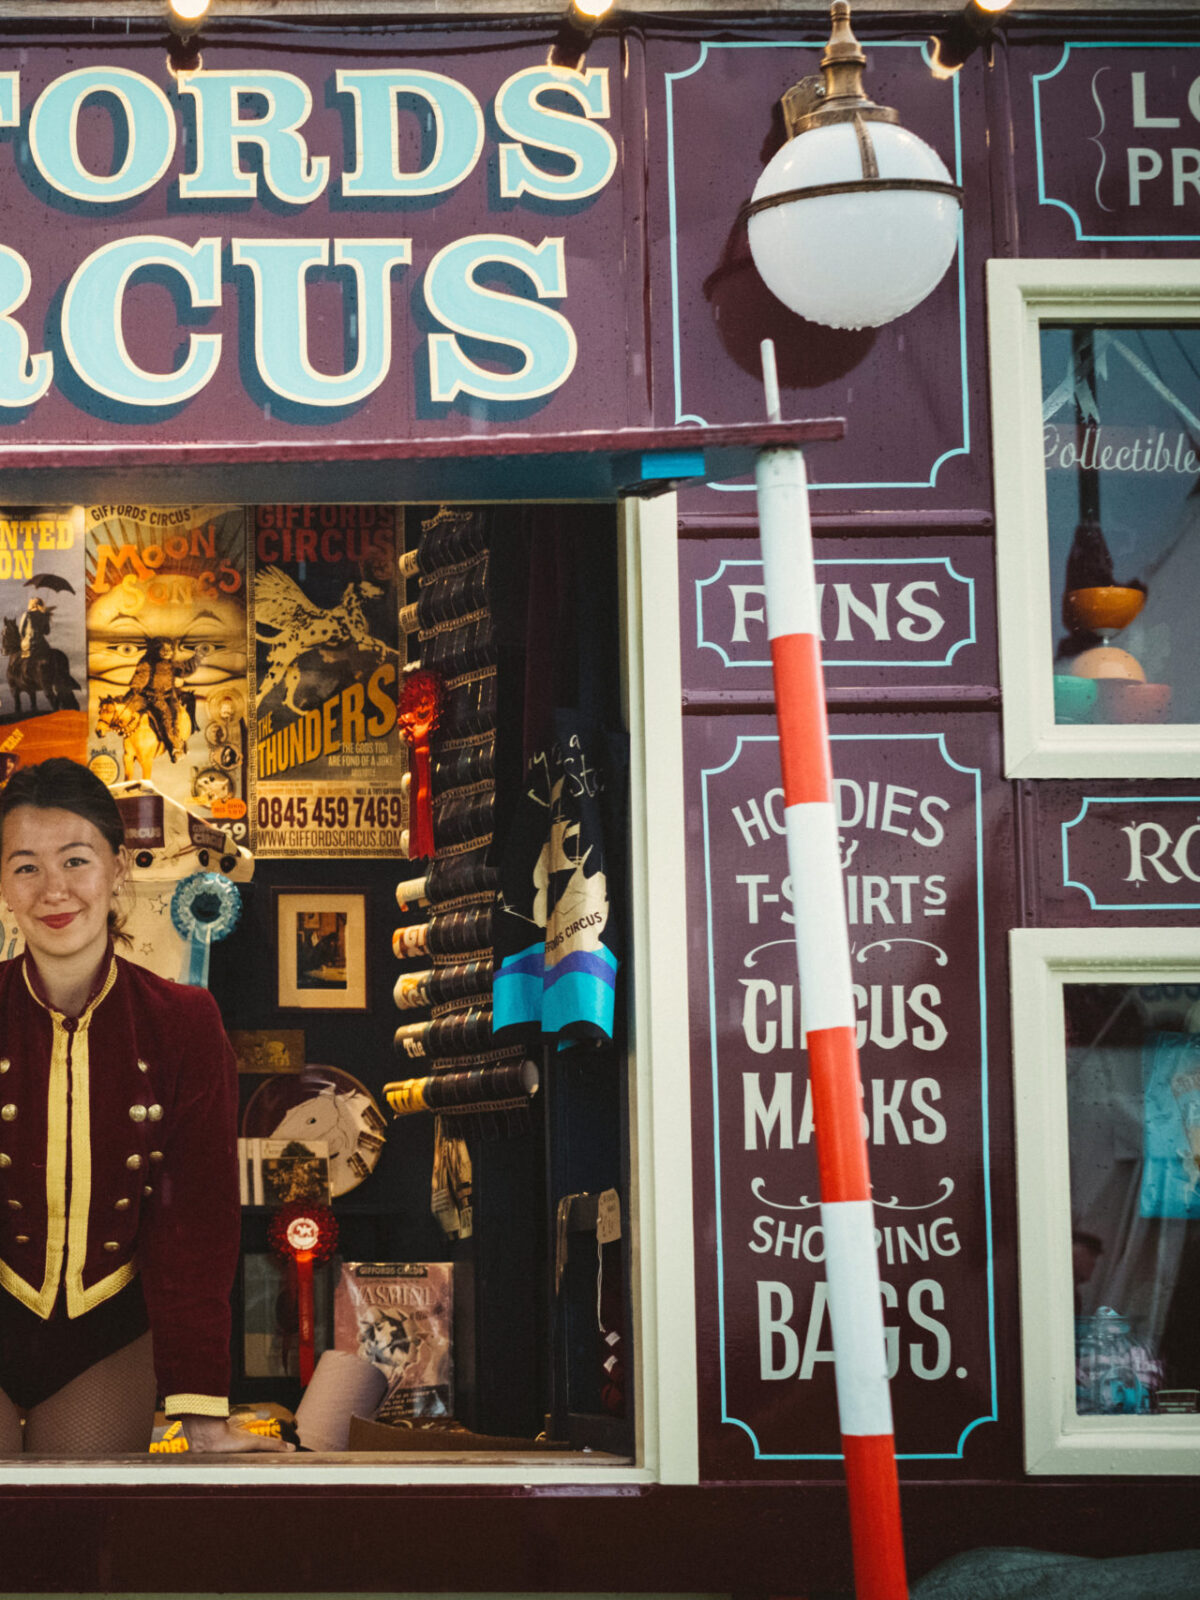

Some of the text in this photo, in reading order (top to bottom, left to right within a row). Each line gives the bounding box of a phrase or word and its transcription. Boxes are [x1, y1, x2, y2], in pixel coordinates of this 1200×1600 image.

[91, 505, 191, 527] GIFFORDS CIRCUS
[256, 505, 395, 528] GIFFORDS
[256, 528, 395, 563] CIRCUS
[728, 581, 946, 643] FNS
[257, 663, 398, 779] THUNDERS
[258, 711, 273, 740] THE
[257, 796, 308, 829] 0845
[312, 796, 349, 829] 459
[353, 796, 401, 829] 7469
[731, 778, 951, 848] HODIES
[256, 831, 402, 848] WWW.GIFFORDSCIRCUS.COM
[564, 911, 603, 939] CIRCUS
[737, 978, 949, 1055] CICUS
[747, 1214, 962, 1266] SHOING
